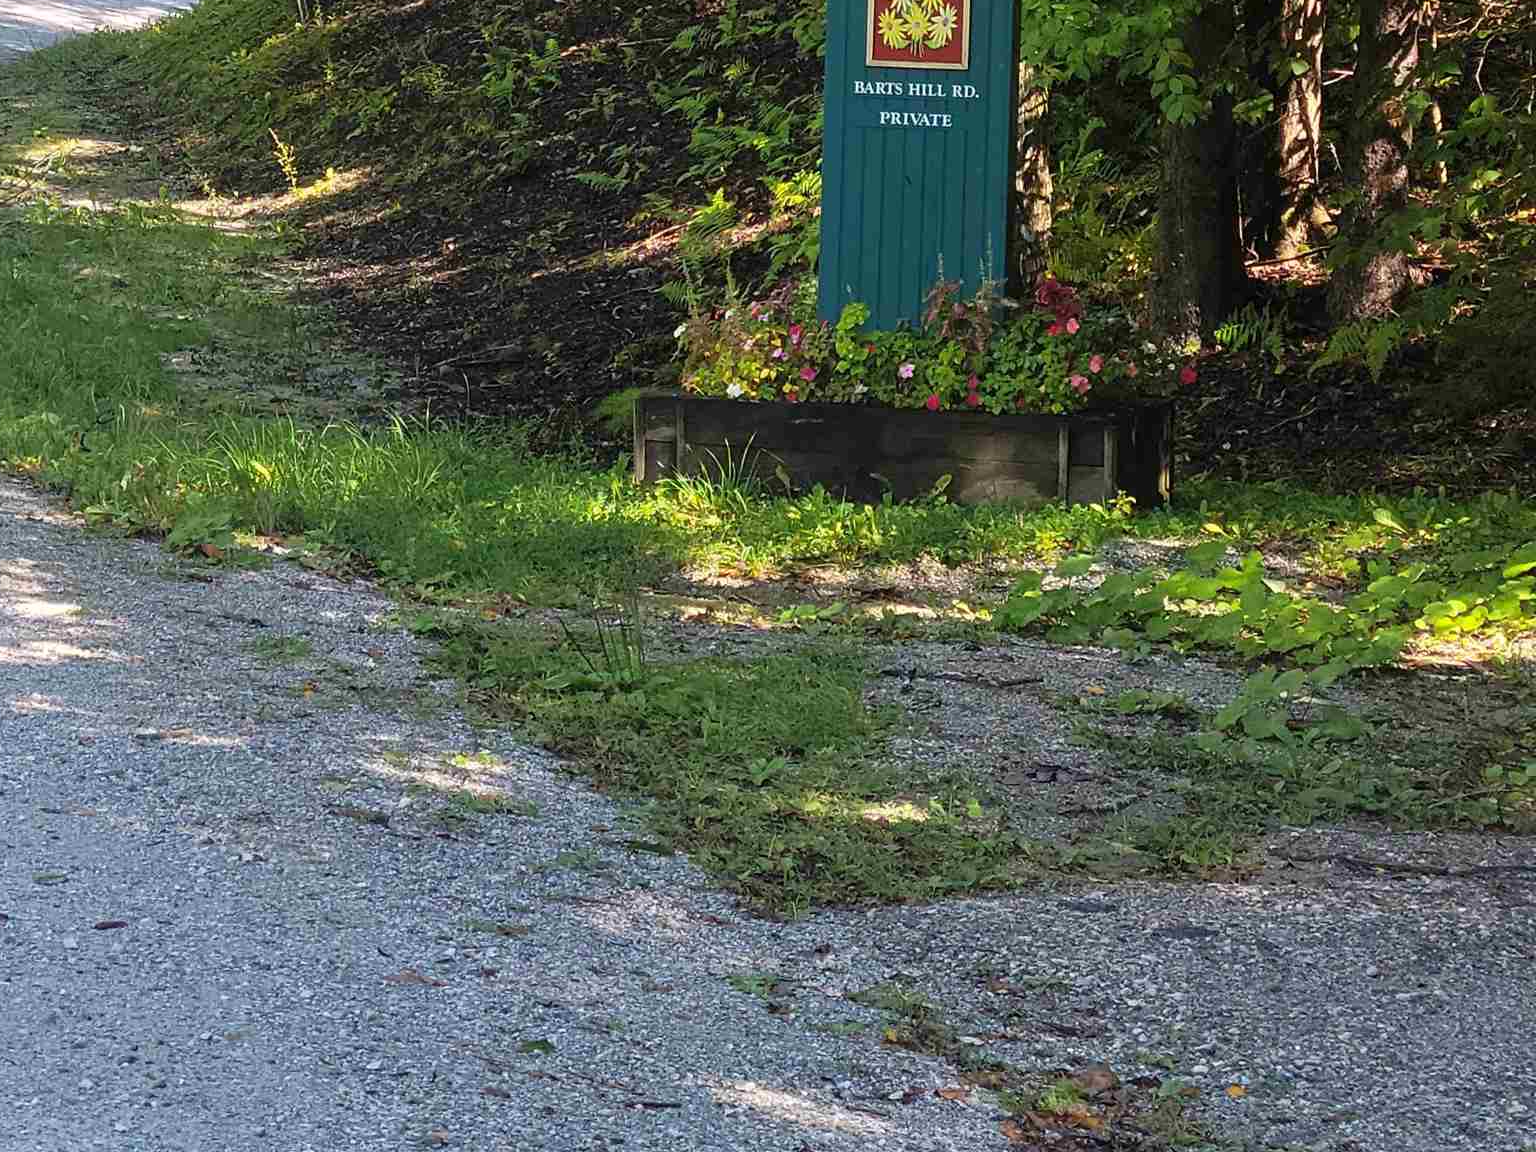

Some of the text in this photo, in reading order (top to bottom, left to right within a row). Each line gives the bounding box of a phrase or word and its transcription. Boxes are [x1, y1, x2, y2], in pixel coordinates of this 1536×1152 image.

[854, 80, 980, 99] BARTS HILL RD.
[879, 111, 953, 128] PRIVATE
